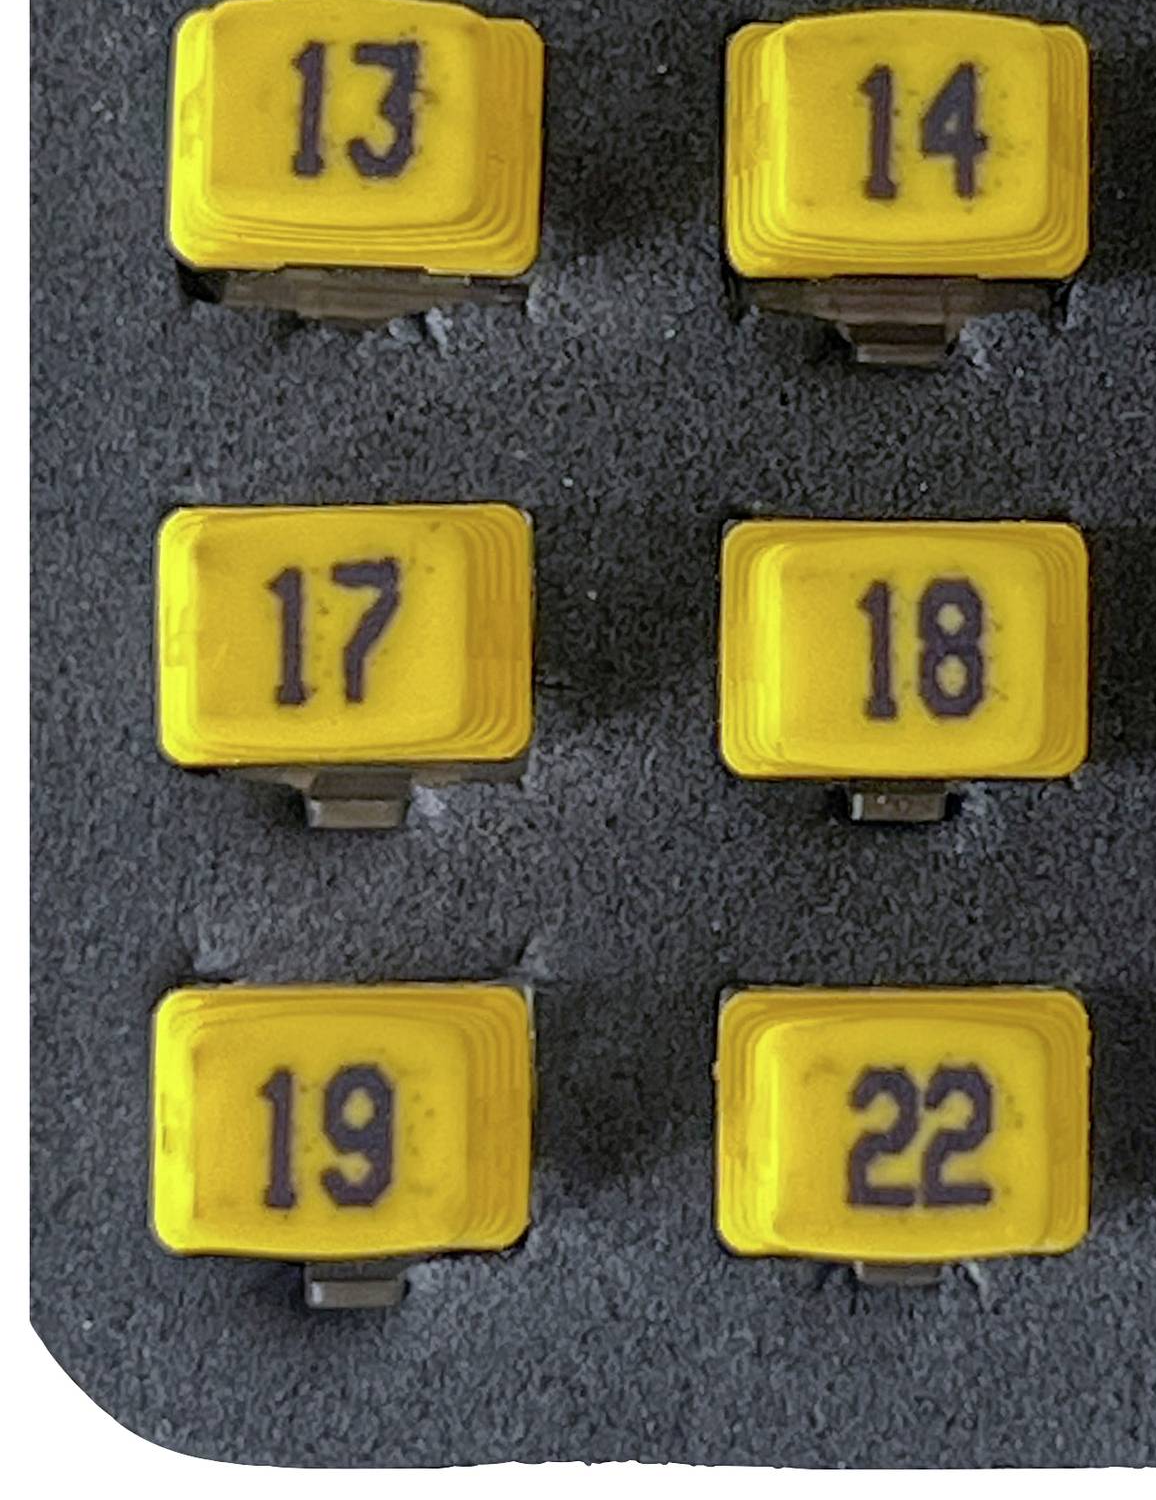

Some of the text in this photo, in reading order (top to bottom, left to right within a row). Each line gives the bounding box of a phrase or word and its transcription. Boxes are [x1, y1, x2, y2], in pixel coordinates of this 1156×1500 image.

[291, 40, 427, 180] 13
[858, 62, 991, 202] 14
[267, 556, 402, 707] 17
[858, 577, 989, 722] 18
[259, 1063, 396, 1211] 19
[845, 1062, 994, 1211] 22
